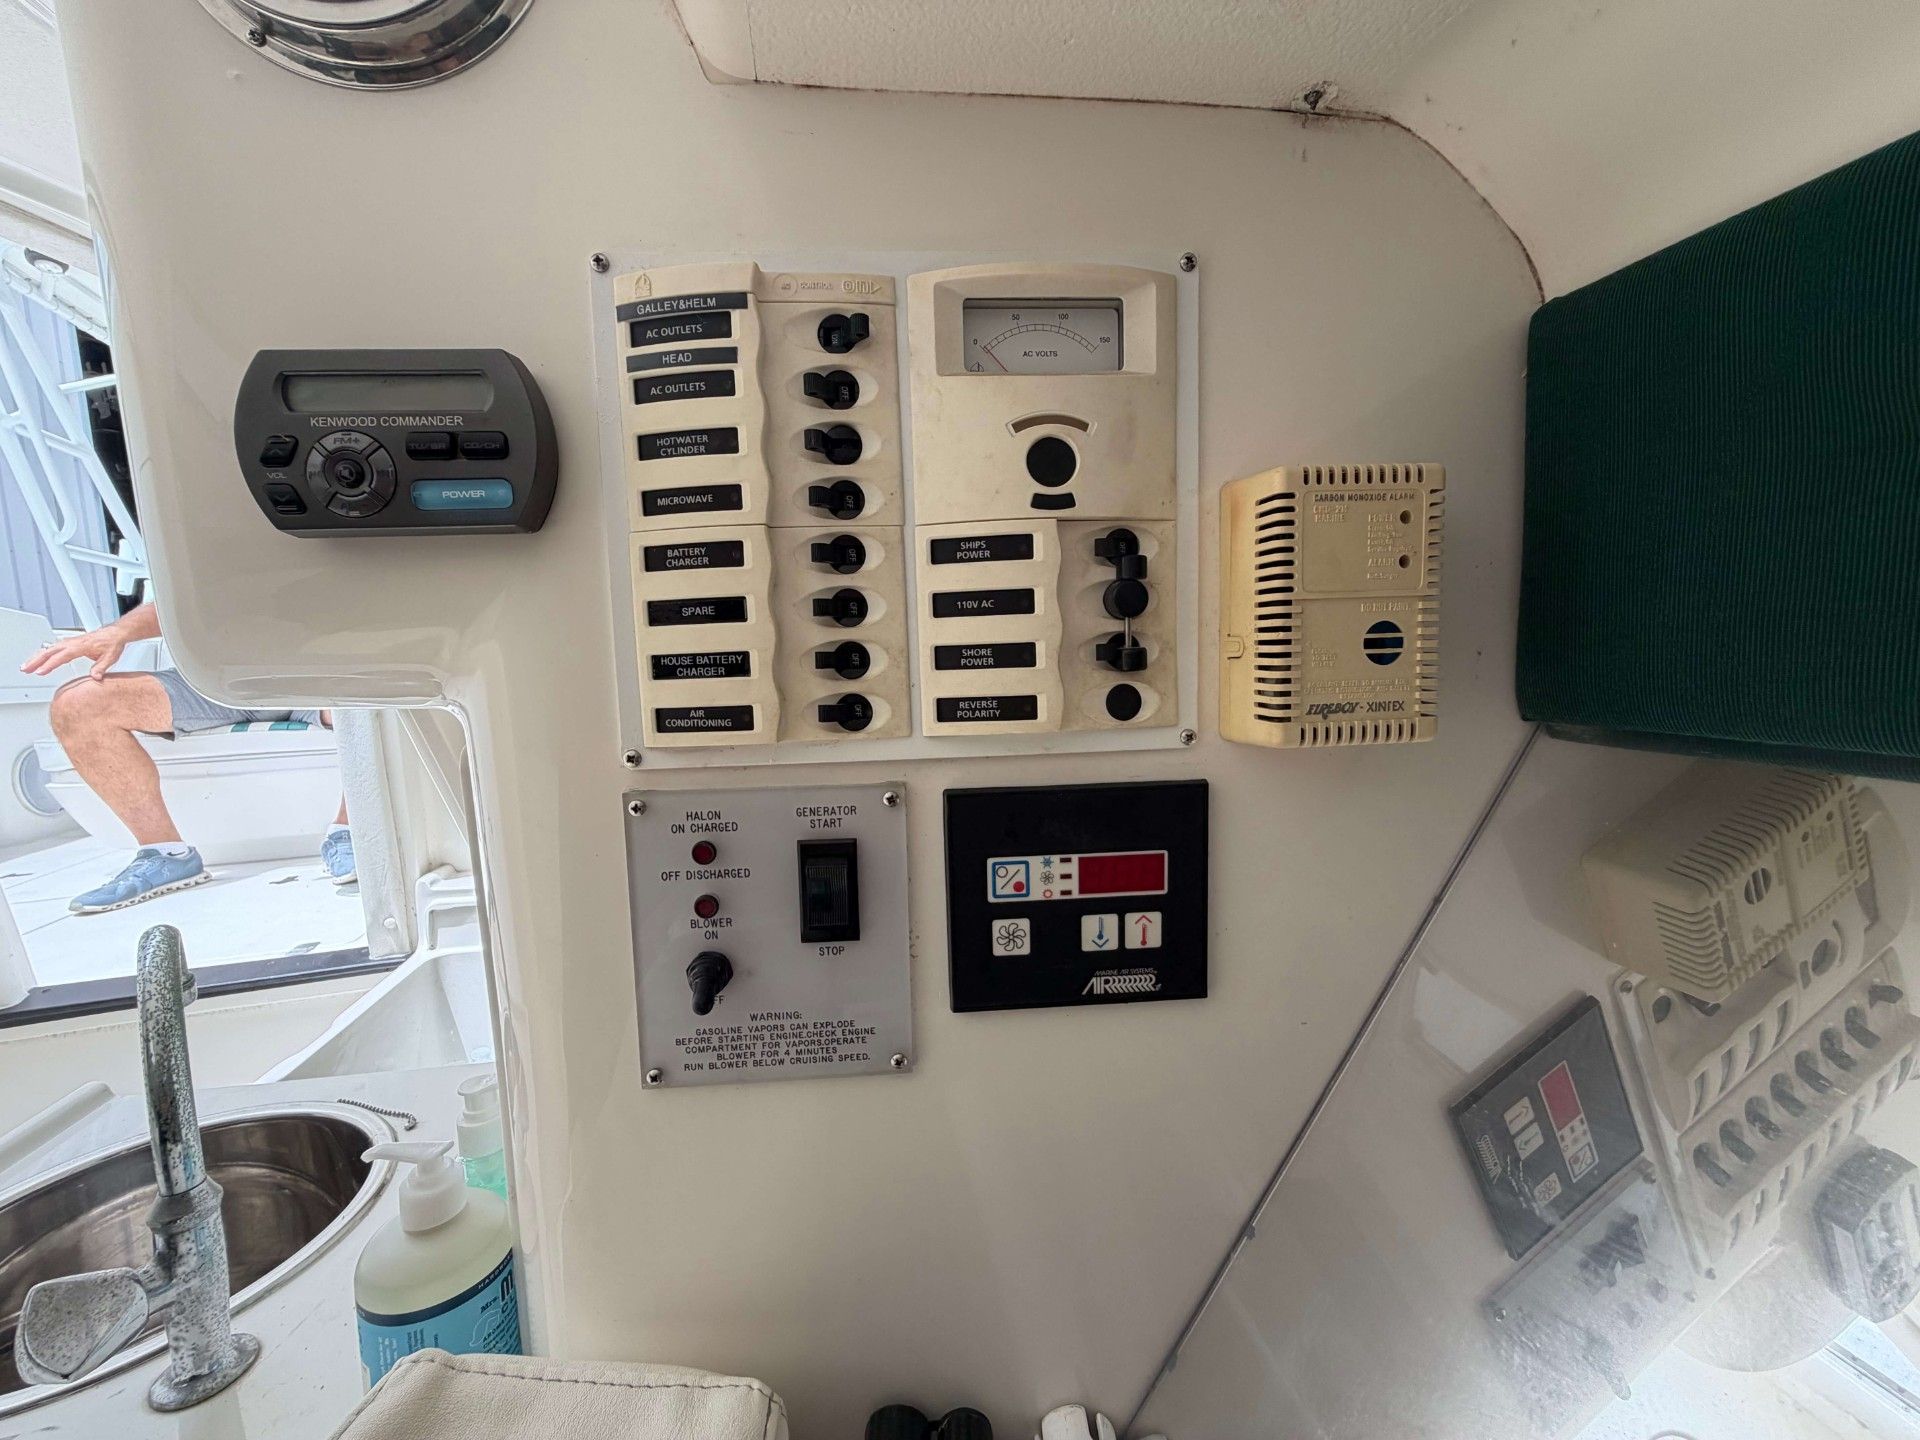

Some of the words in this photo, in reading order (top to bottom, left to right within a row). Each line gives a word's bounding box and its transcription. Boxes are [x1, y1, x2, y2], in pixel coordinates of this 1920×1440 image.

[637, 297, 716, 315] GALLEY&HELM
[646, 327, 659, 338] AC
[661, 324, 703, 337] OUTLETS
[662, 352, 692, 364] HEAD
[1022, 350, 1034, 358] AC
[1035, 350, 1058, 358] VOLTS
[650, 385, 663, 395] AC
[664, 382, 706, 394] OUTLETS
[841, 386, 849, 401] OFF
[310, 416, 377, 427] KENWOOD
[380, 416, 463, 427] COMMANDER
[656, 435, 709, 447] HOTWATER
[660, 445, 706, 457] CYLINDER
[442, 490, 486, 499] POWER
[657, 494, 714, 506] MICROWAVE
[1314, 493, 1345, 502] CARBON
[1347, 493, 1387, 502] MONOXIDE
[1389, 492, 1415, 501] ALARM
[846, 495, 854, 509] OFF
[960, 540, 987, 550] SHIPS
[667, 546, 707, 557] BATTERY
[849, 549, 857, 563] OFF
[956, 550, 990, 560] POWER
[666, 556, 709, 567] CHARGER
[850, 602, 858, 616] OFF
[956, 600, 979, 609] 110V
[981, 600, 995, 608] AC
[682, 606, 715, 616] SPARE
[962, 648, 993, 657] SHORE
[660, 656, 694, 665] HOUSE
[696, 654, 743, 665] BATTERY
[852, 653, 860, 667] OFF
[960, 657, 994, 666] POWER
[676, 666, 725, 677] CHARGER
[959, 700, 998, 710] REVERSE
[1305, 701, 1360, 720] FIREBOY
[1366, 700, 1405, 712] XINTEX
[690, 709, 705, 718] AIR
[957, 708, 1001, 719] POLARITY
[665, 718, 732, 728] CONDITIONING
[686, 810, 721, 821] HALON
[796, 805, 857, 818] GENERATOR
[671, 823, 685, 833] ON
[690, 822, 738, 833] CHARGED
[810, 818, 843, 829] START
[661, 871, 681, 881] OFF
[685, 868, 751, 881] DISCHARGED
[690, 917, 733, 929] BLOWER
[704, 930, 719, 940] ON
[818, 946, 845, 956] STOP
[750, 1011, 803, 1022] WARNING:
[695, 1026, 743, 1036] GASOLINE
[748, 1024, 785, 1034] VAPORS
[790, 1023, 808, 1031] CAN
[813, 1020, 856, 1029] EXPLODE
[675, 1037, 713, 1046] BEFORE
[718, 1034, 765, 1044] STARTING
[842, 1027, 876, 1036] ENGINE
[685, 1043, 757, 1054] COMPARTMENT
[762, 1041, 781, 1049] FOR
[716, 1052, 756, 1061] BLOWER
[760, 1050, 780, 1058] FOR
[795, 1047, 838, 1056] MINUTES
[684, 1063, 704, 1071] RUN
[708, 1061, 748, 1070] BLOWER
[752, 1058, 785, 1067] BELOW
[789, 1055, 834, 1065] CRUISING
[838, 1053, 871, 1062] SPEED.
